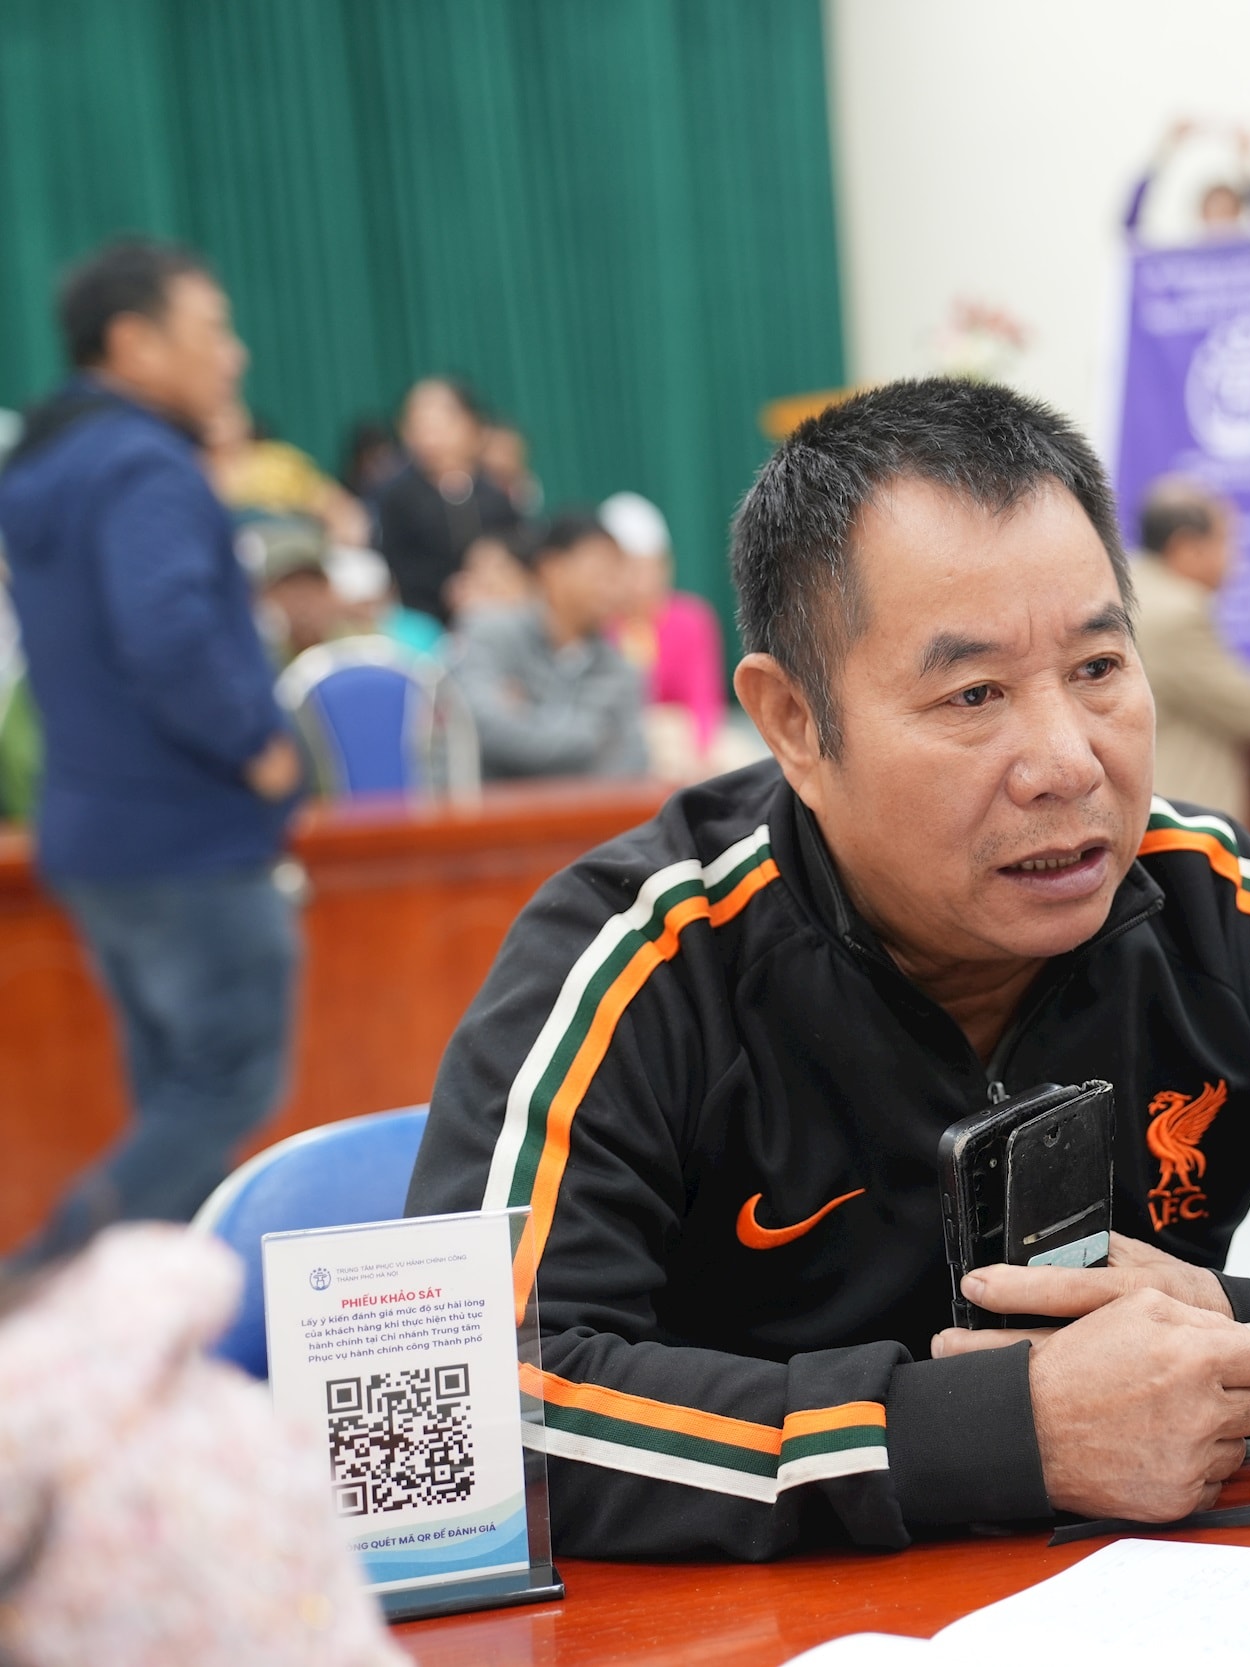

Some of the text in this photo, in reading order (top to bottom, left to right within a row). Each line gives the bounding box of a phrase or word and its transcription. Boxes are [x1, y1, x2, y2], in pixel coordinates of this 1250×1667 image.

[336, 1266, 358, 1274] TRUNG
[361, 1263, 374, 1271] TÂM
[376, 1262, 394, 1270] PHỤC
[406, 1258, 424, 1266] HÀNH
[426, 1256, 446, 1264] CHÍNH
[448, 1253, 467, 1261] CÔNG
[337, 1274, 358, 1282] THÀNH
[342, 1287, 442, 1309] PHIẾU KHẢO SÁT
[301, 1298, 485, 1329] Lấy ý kiến đánh giá mức độ sự hài lòng
[305, 1310, 483, 1339] của khách hàng khi thực hiện thủ tục
[308, 1333, 483, 1363] Phục vụ hành chính công Thành phố
[309, 1322, 480, 1351] hành chính tại Chi nhánh Trung tâm
[371, 1535, 397, 1549] QUÉT
[399, 1533, 415, 1544] MÃ
[417, 1532, 431, 1542] QR
[433, 1528, 446, 1540] ĐỂ
[448, 1525, 477, 1538] ĐÁNH
[479, 1522, 497, 1533] GIÁ
